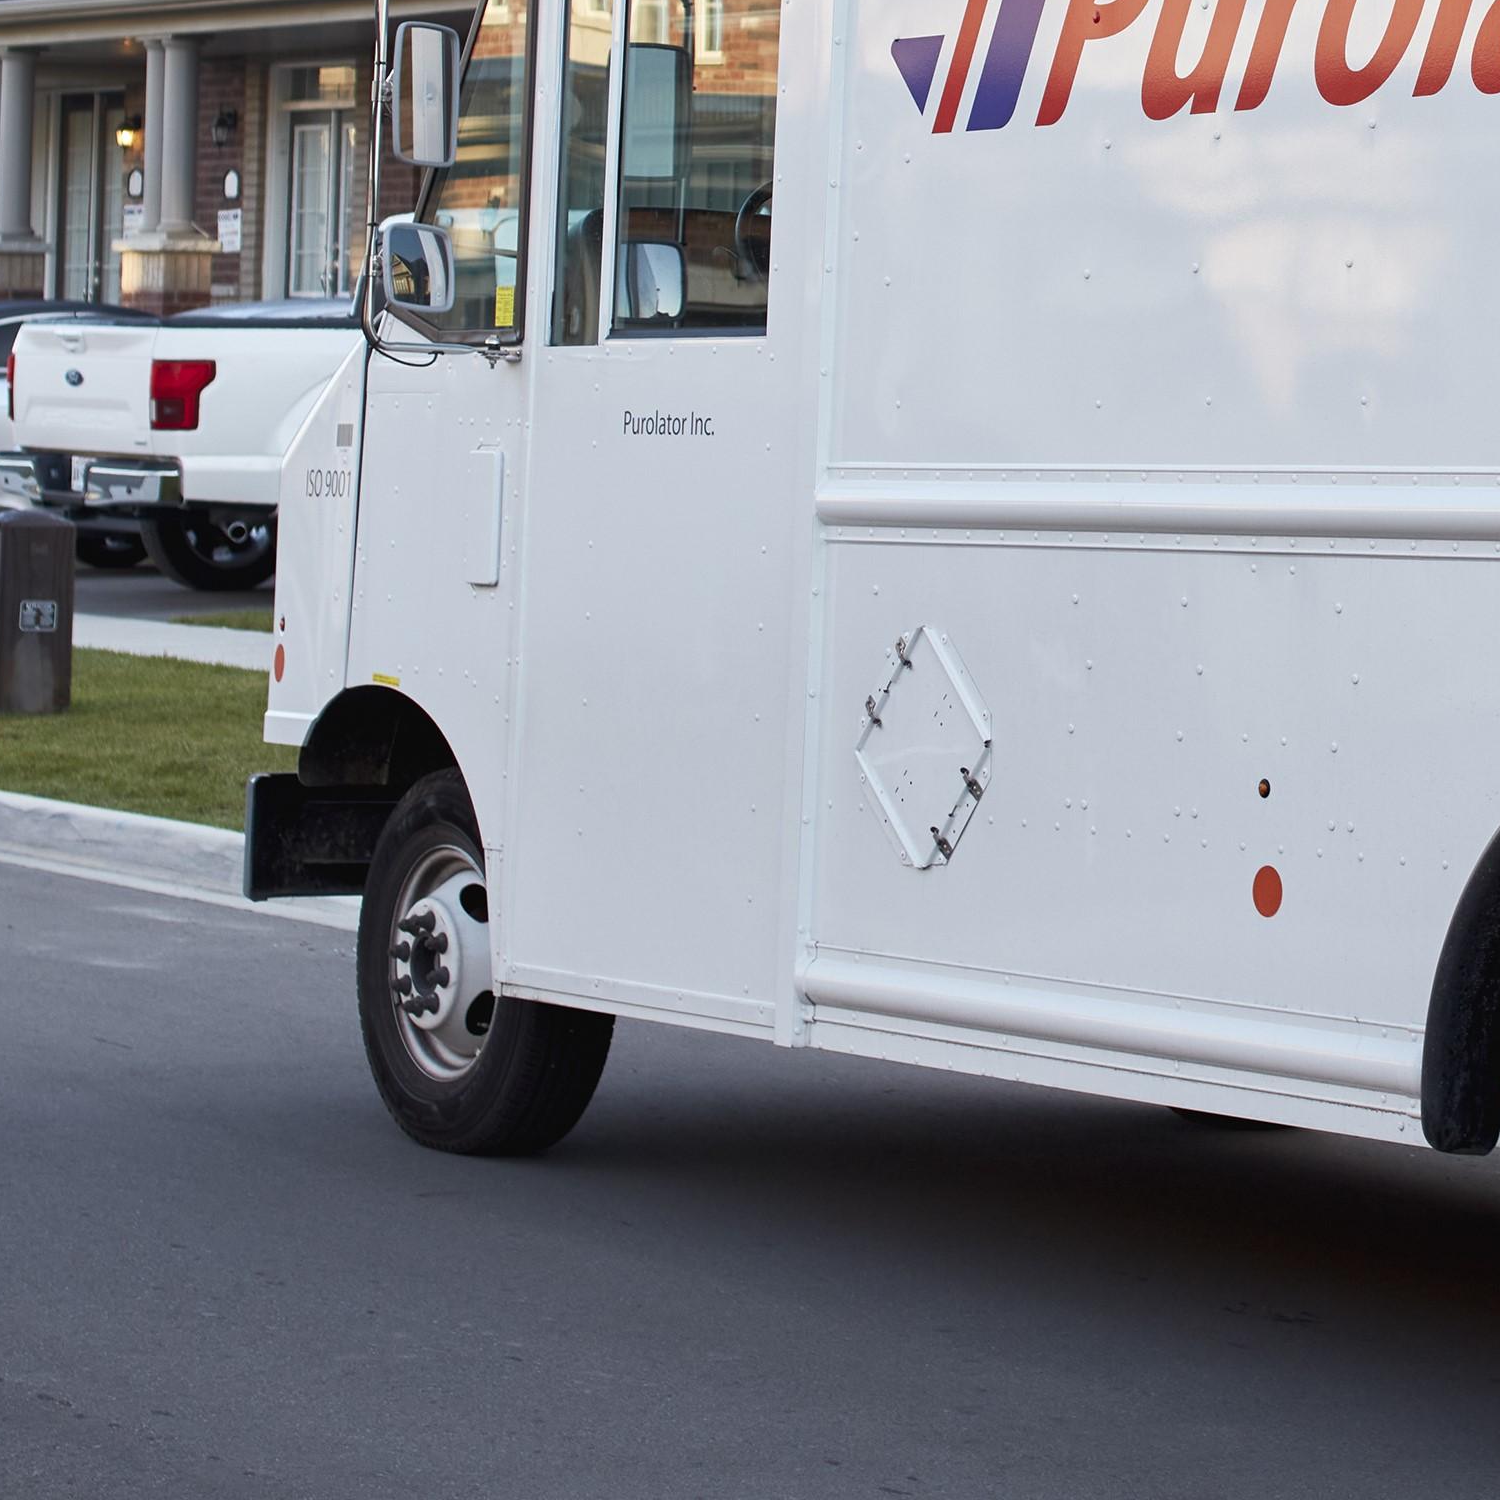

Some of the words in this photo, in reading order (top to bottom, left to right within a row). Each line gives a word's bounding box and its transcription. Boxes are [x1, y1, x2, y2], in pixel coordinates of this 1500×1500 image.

[623, 410, 687, 435] Purolator
[690, 411, 715, 435] Inc.
[306, 469, 323, 497] ISO
[325, 470, 351, 497] 9001
